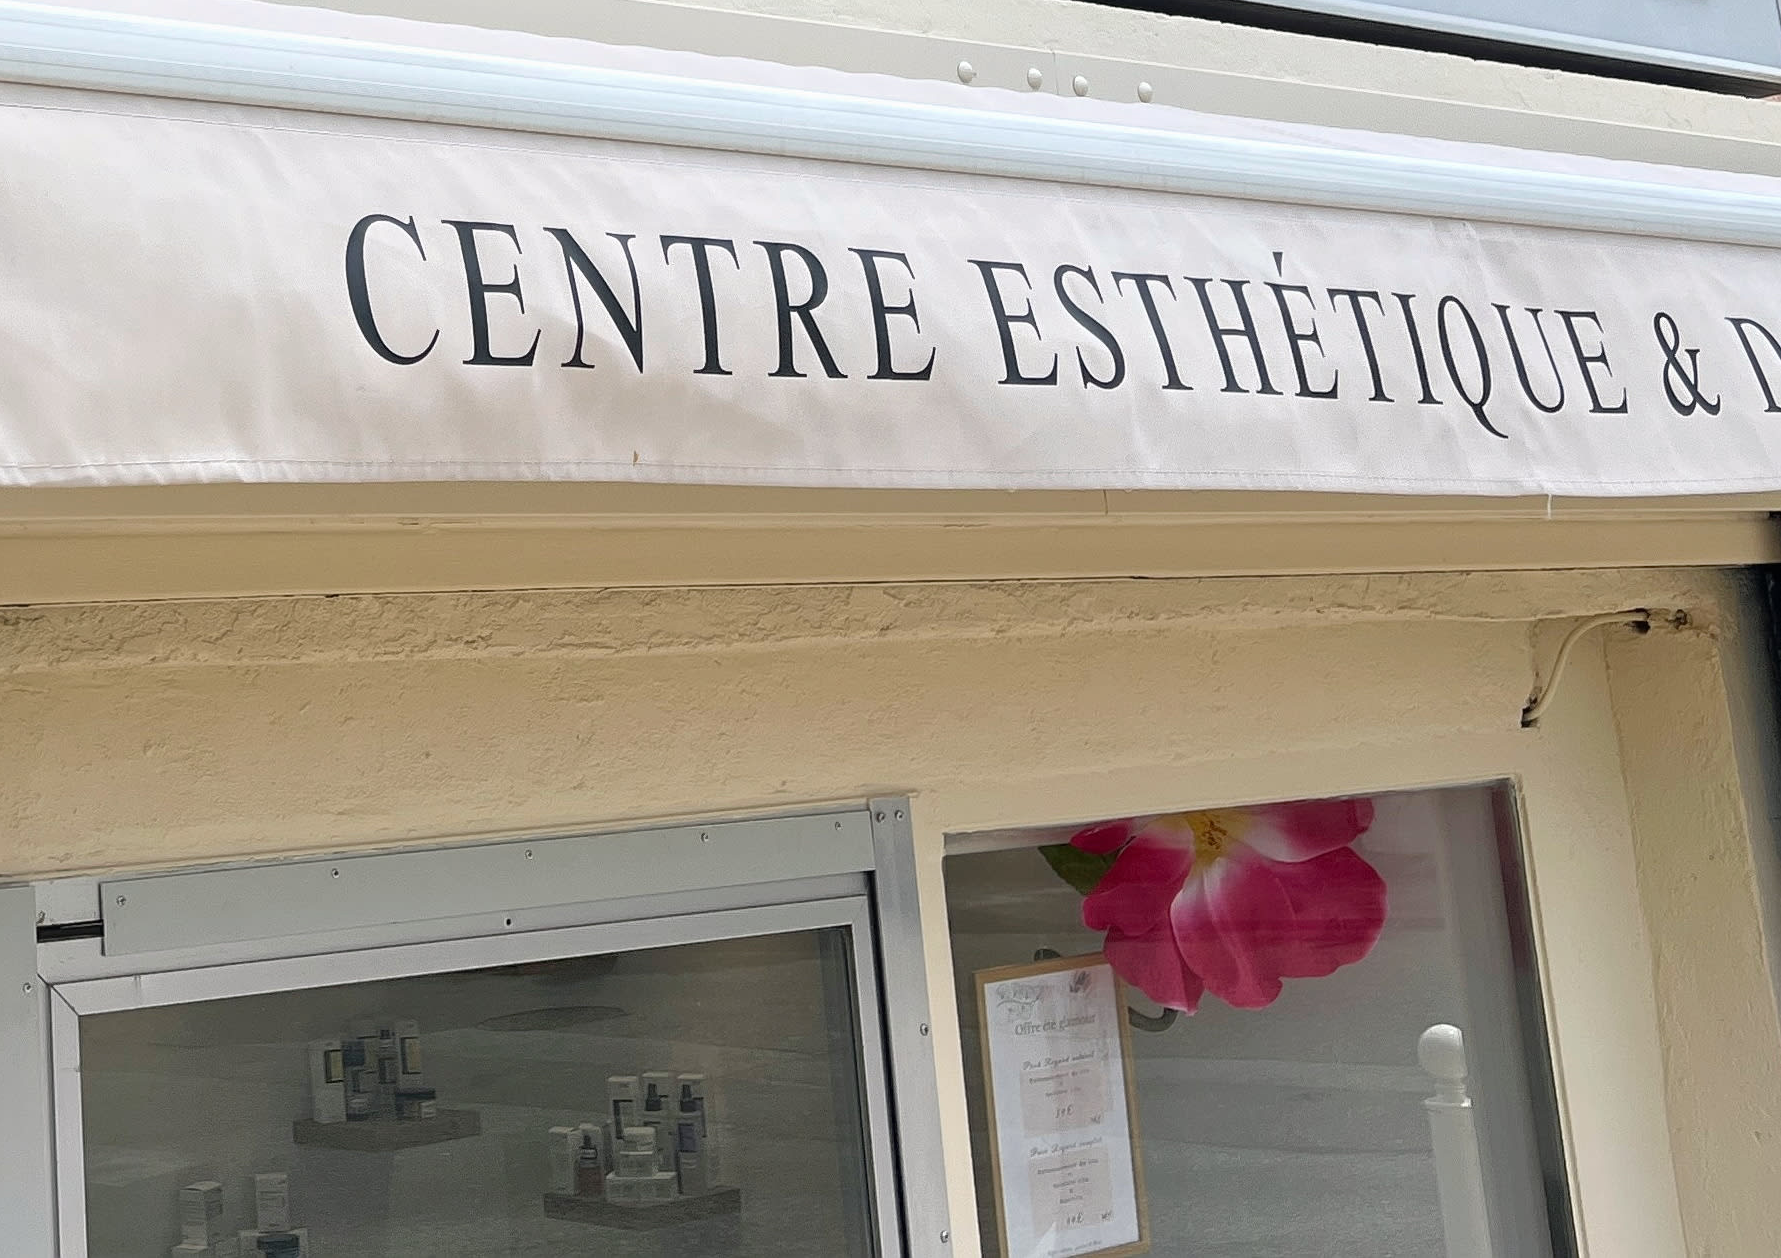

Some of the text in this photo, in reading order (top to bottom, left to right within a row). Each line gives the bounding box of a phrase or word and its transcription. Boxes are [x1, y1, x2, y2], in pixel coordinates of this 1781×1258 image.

[346, 214, 937, 382] CENTRE
[967, 252, 1628, 439] ESTHÉTIQUE
[1652, 311, 1721, 417] &
